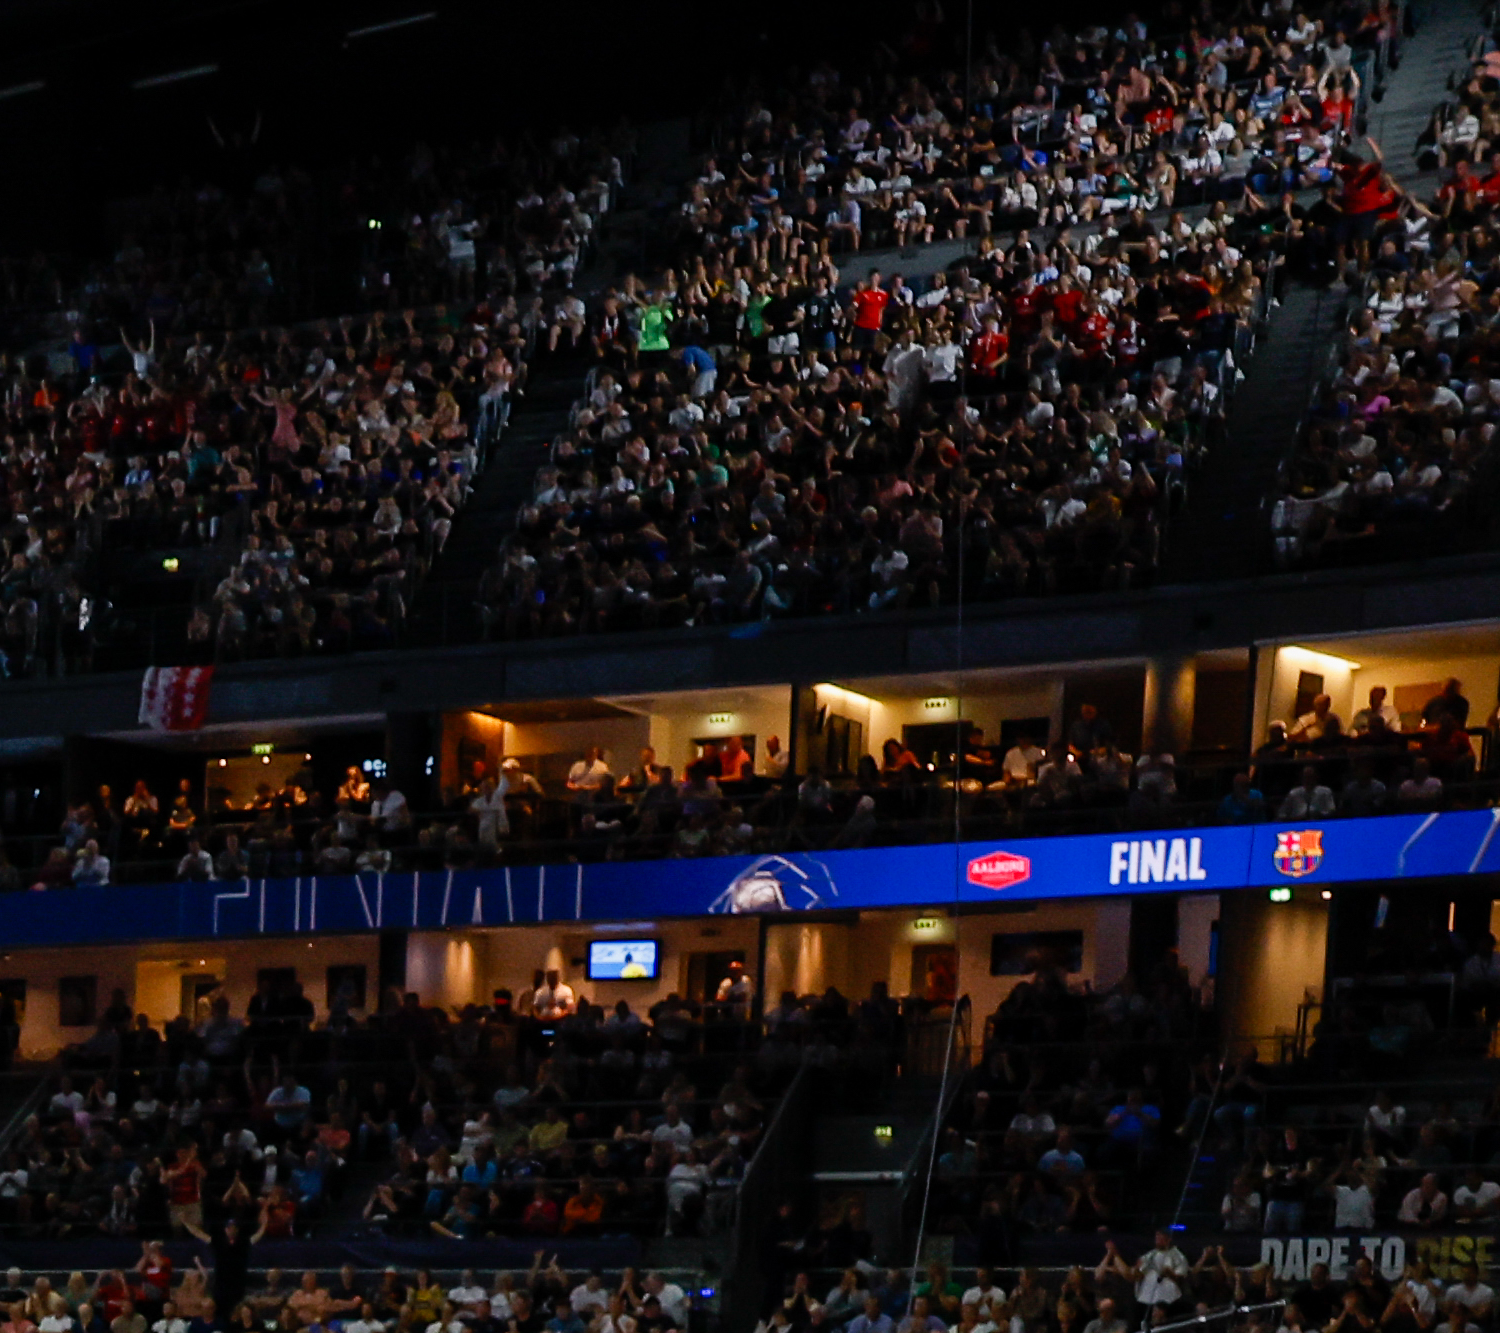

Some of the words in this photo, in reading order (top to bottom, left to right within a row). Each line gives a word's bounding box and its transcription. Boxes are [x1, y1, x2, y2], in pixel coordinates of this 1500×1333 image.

[1108, 837, 1206, 885] FINAL
[1261, 1237, 1350, 1281] DARE
[1360, 1236, 1406, 1281] TO
